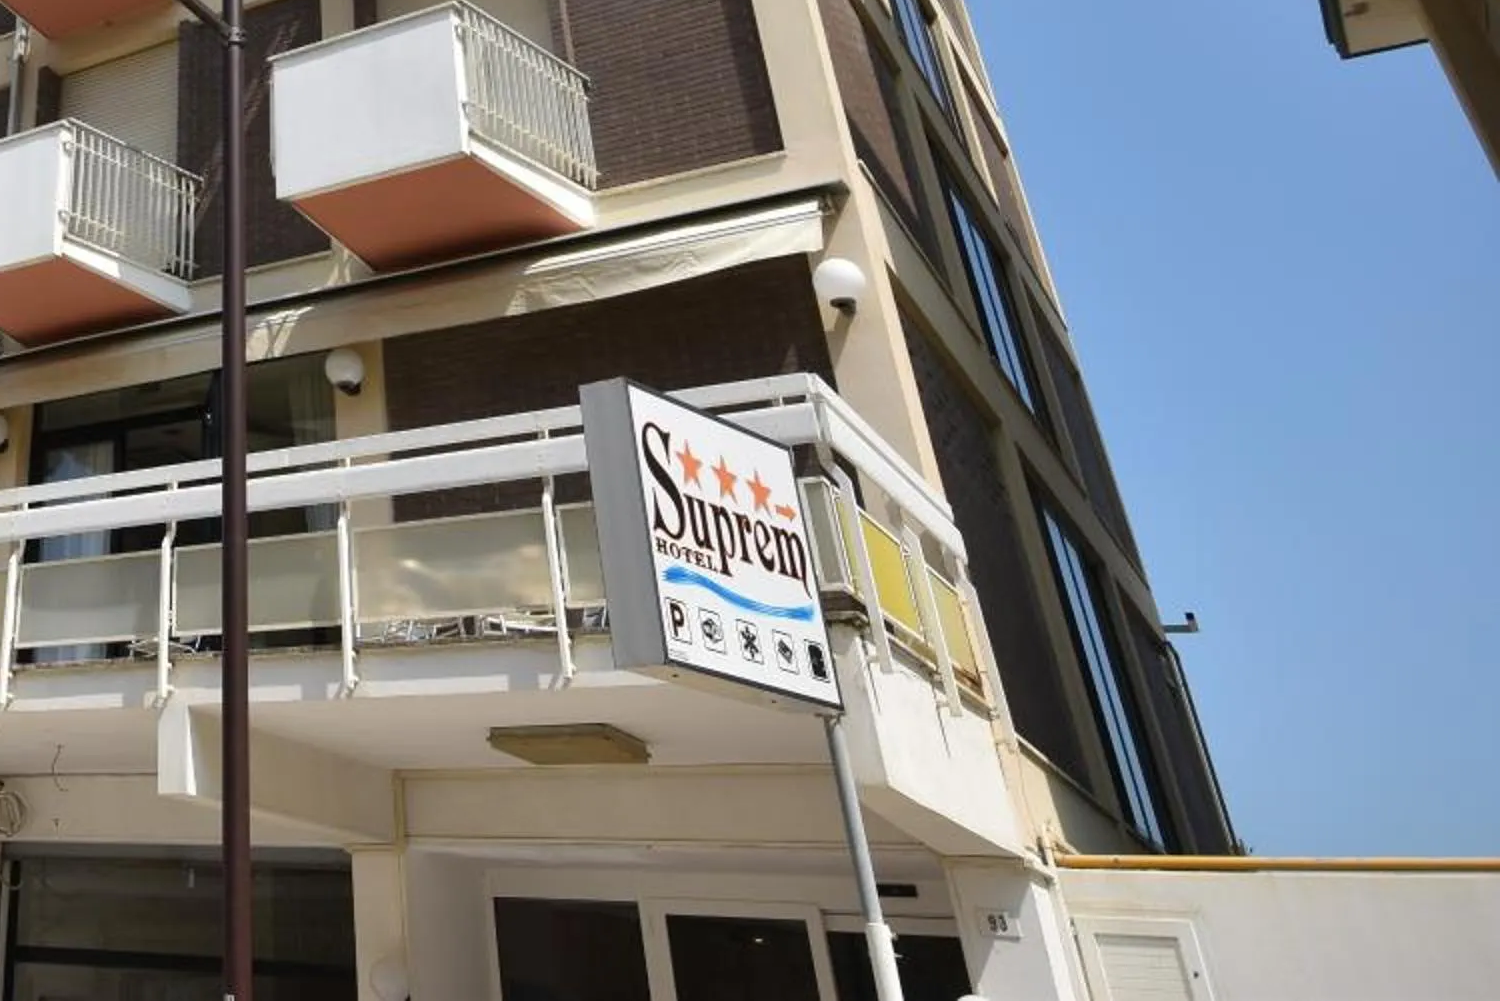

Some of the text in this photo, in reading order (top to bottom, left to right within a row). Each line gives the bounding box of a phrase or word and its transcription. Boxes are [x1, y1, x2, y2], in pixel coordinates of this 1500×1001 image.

[641, 421, 813, 600] Suprem
[655, 536, 718, 574] HOTEL
[668, 601, 686, 638] P
